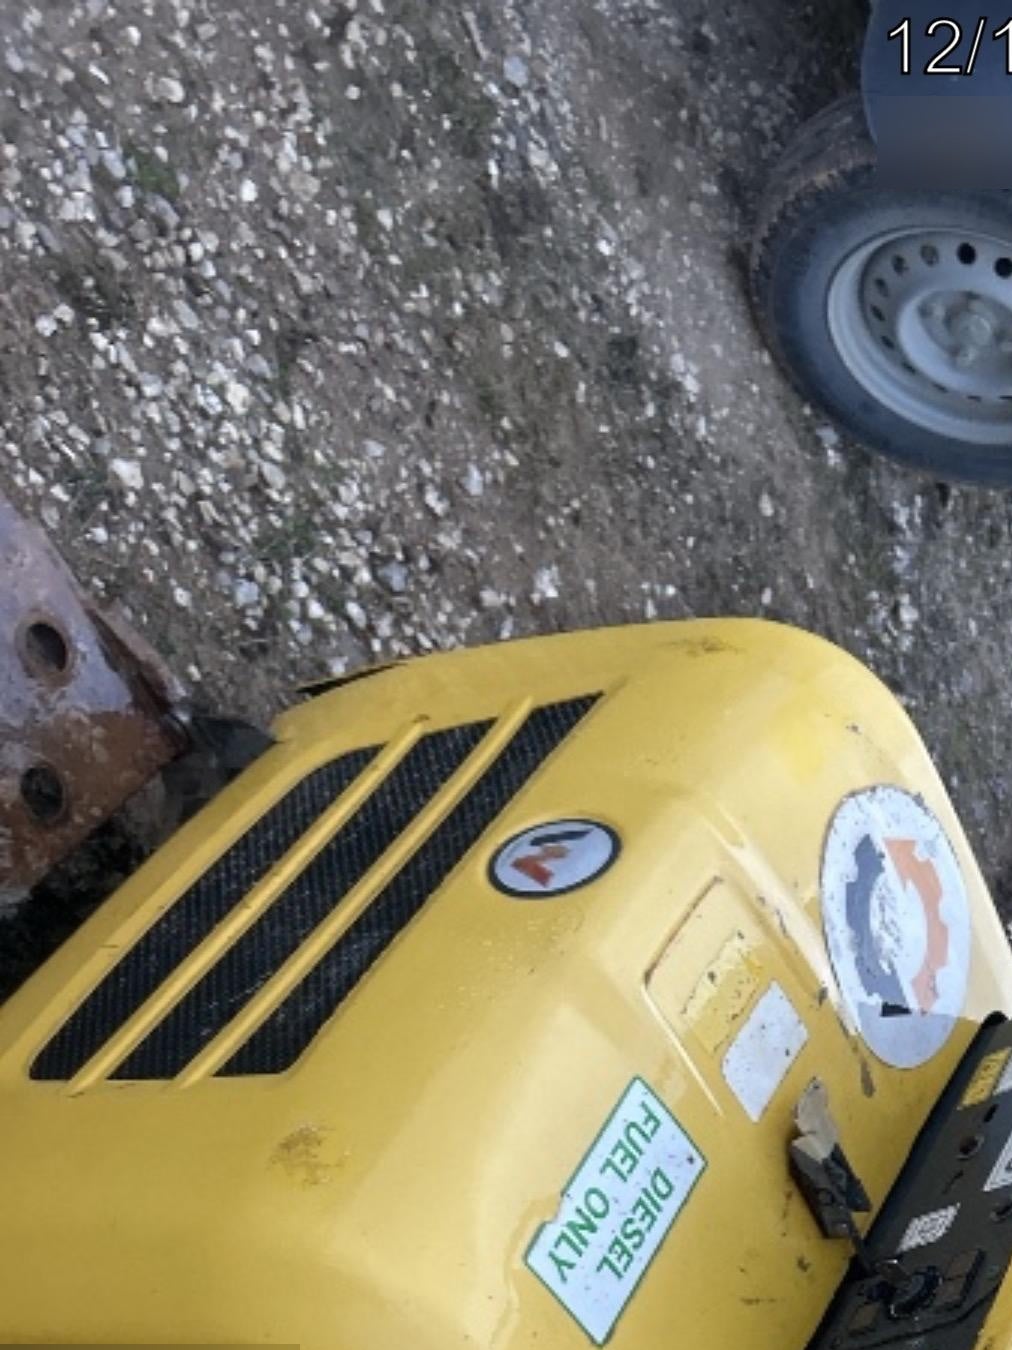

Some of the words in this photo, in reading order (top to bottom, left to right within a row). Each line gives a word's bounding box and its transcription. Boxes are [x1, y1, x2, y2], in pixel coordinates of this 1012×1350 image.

[599, 1100, 662, 1183] FUEL
[548, 1187, 610, 1284] ONLY
[595, 1166, 675, 1281] DIESEL
